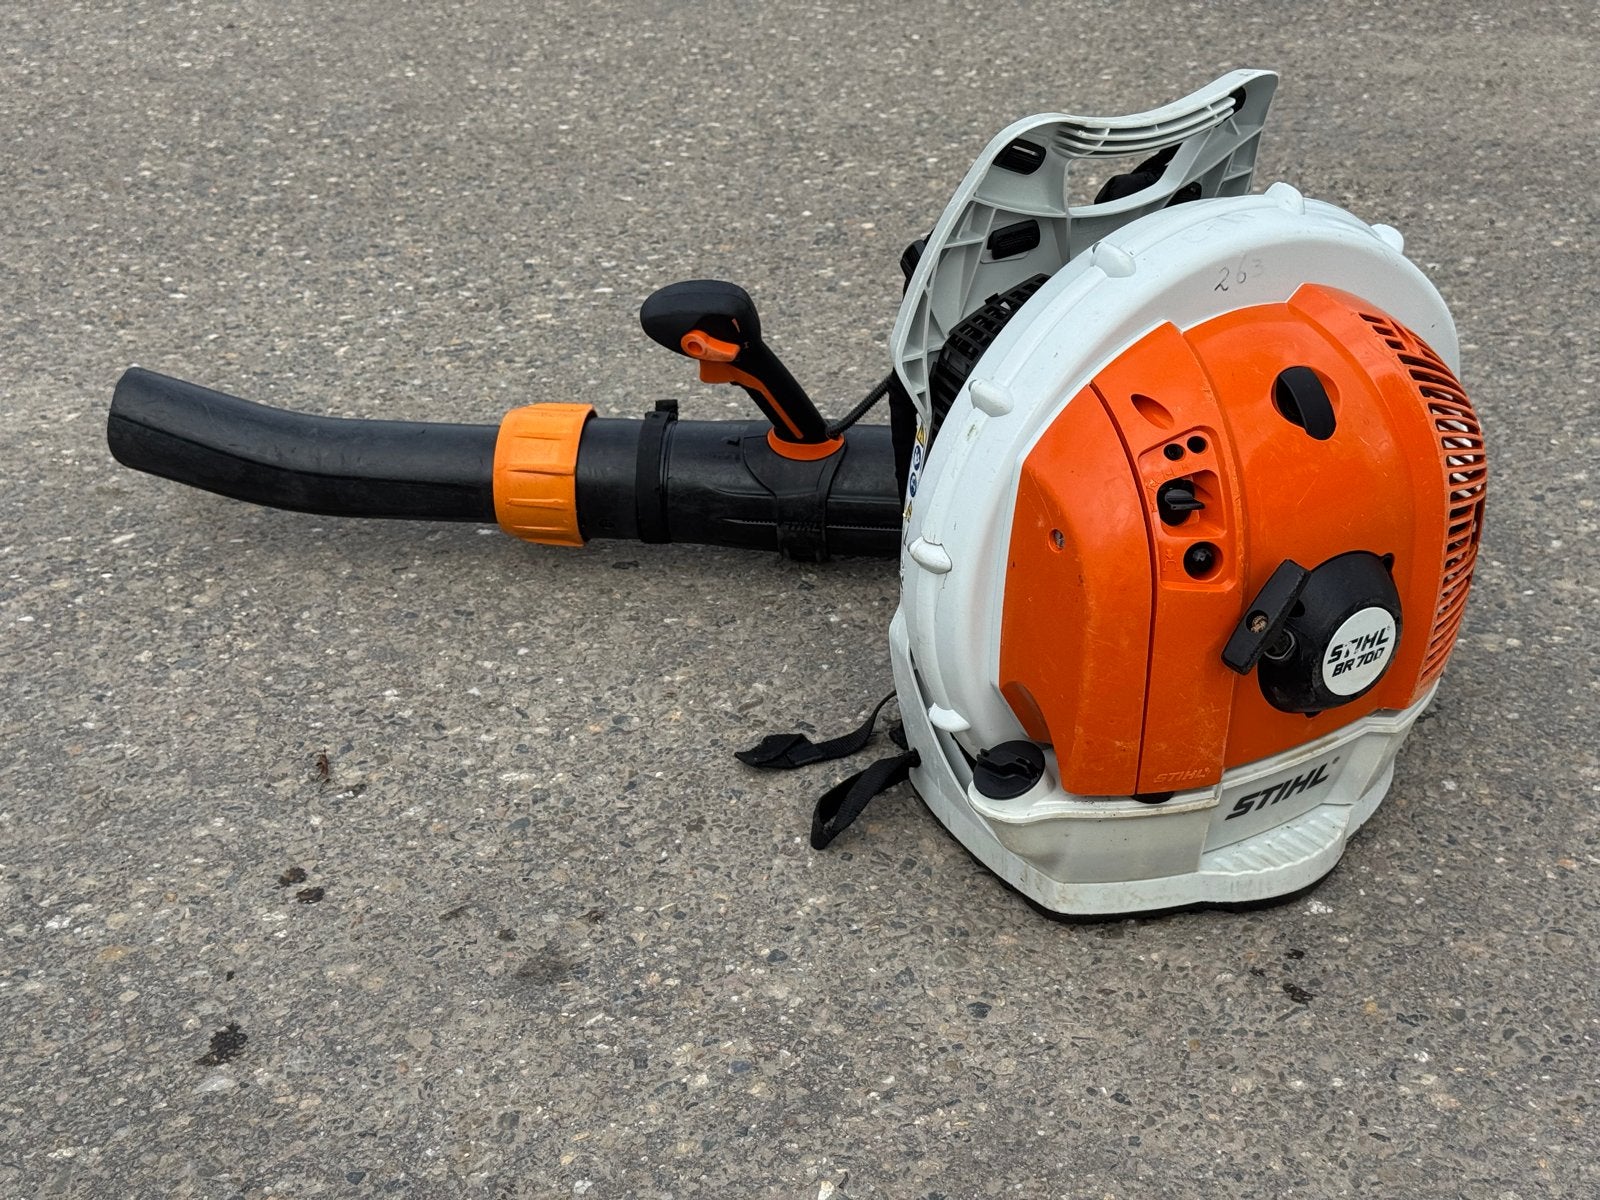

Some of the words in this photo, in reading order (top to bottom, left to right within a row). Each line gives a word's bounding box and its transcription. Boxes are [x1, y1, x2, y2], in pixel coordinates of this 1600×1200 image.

[1332, 658, 1355, 677] BR
[1356, 647, 1385, 668] 700
[1225, 763, 1329, 820] STIHL
